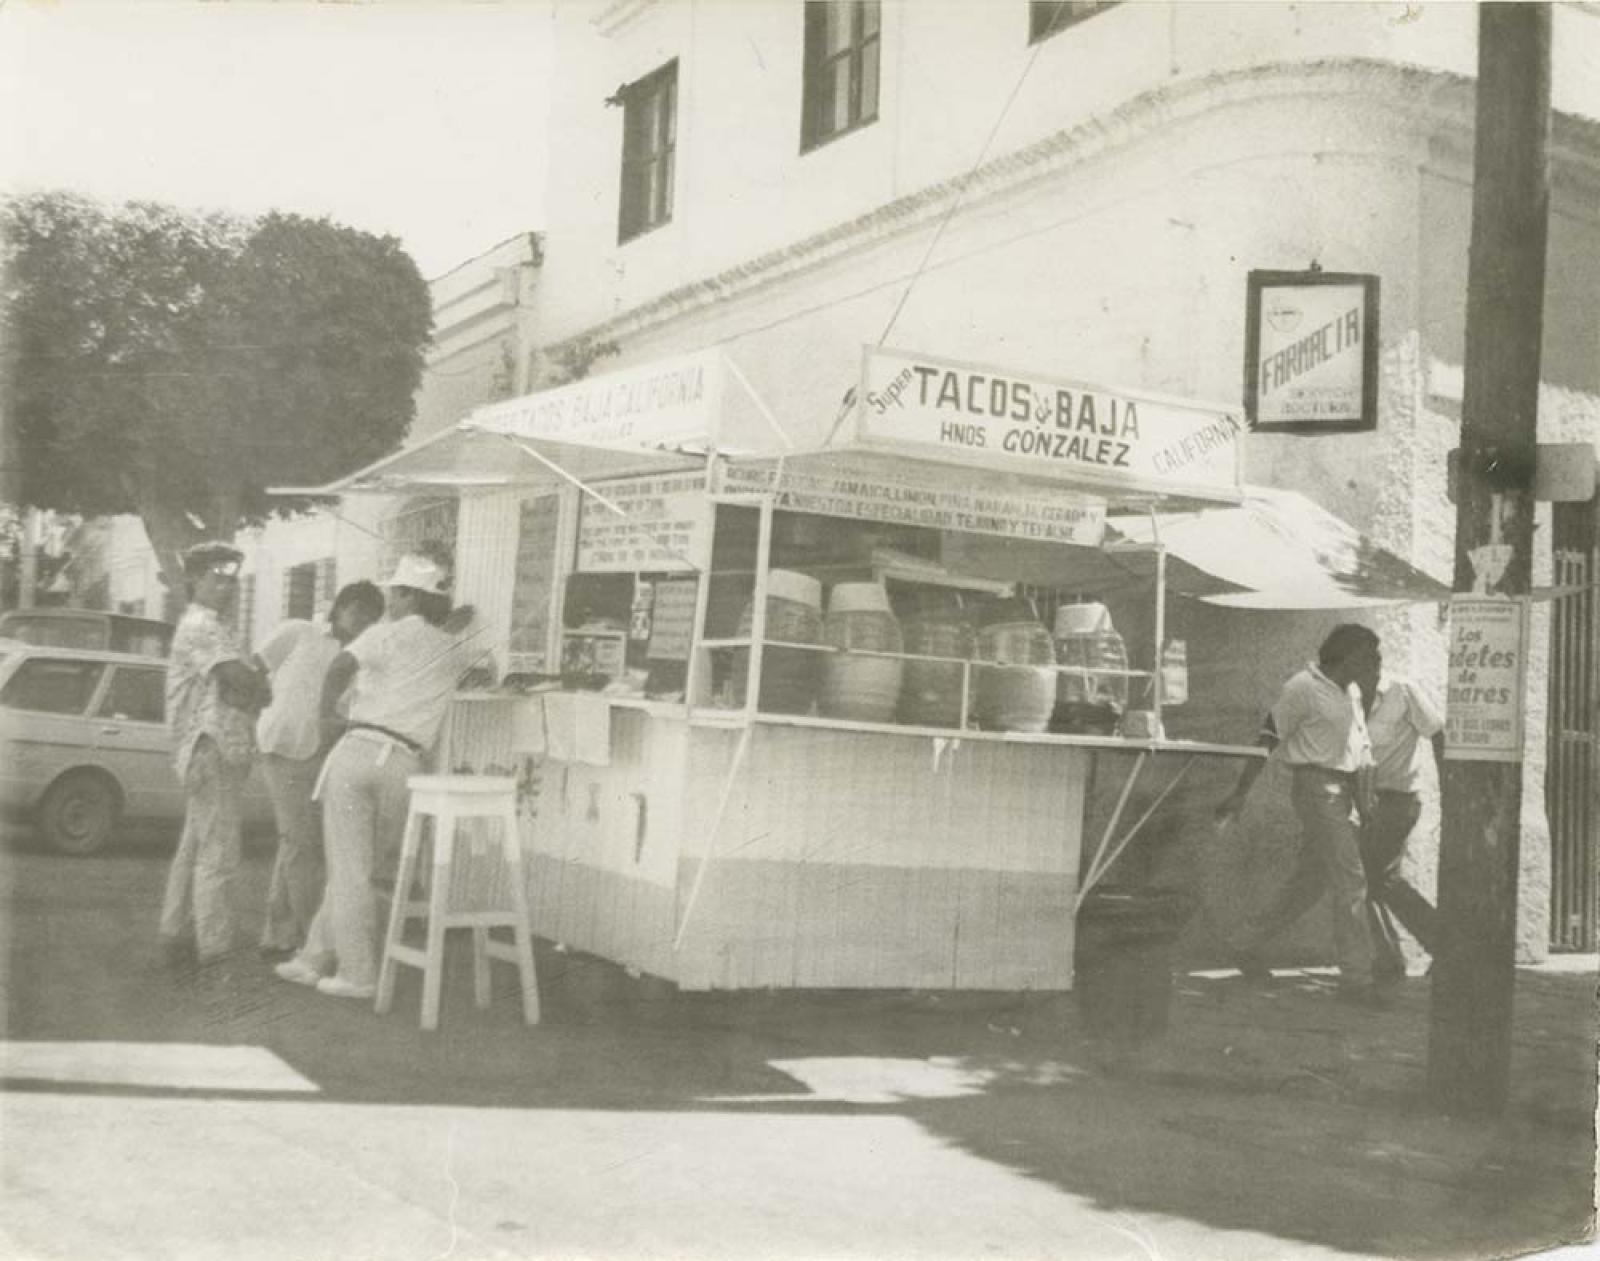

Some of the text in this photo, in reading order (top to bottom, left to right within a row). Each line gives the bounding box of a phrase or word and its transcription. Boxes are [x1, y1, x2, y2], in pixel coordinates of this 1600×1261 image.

[1262, 308, 1359, 396] FARMACIA
[913, 365, 1031, 422] TACOS
[1056, 389, 1140, 440] BAJA
[1002, 428, 1131, 468] GONZALEZ
[1457, 626, 1482, 642] Los
[1458, 669, 1477, 684] de
